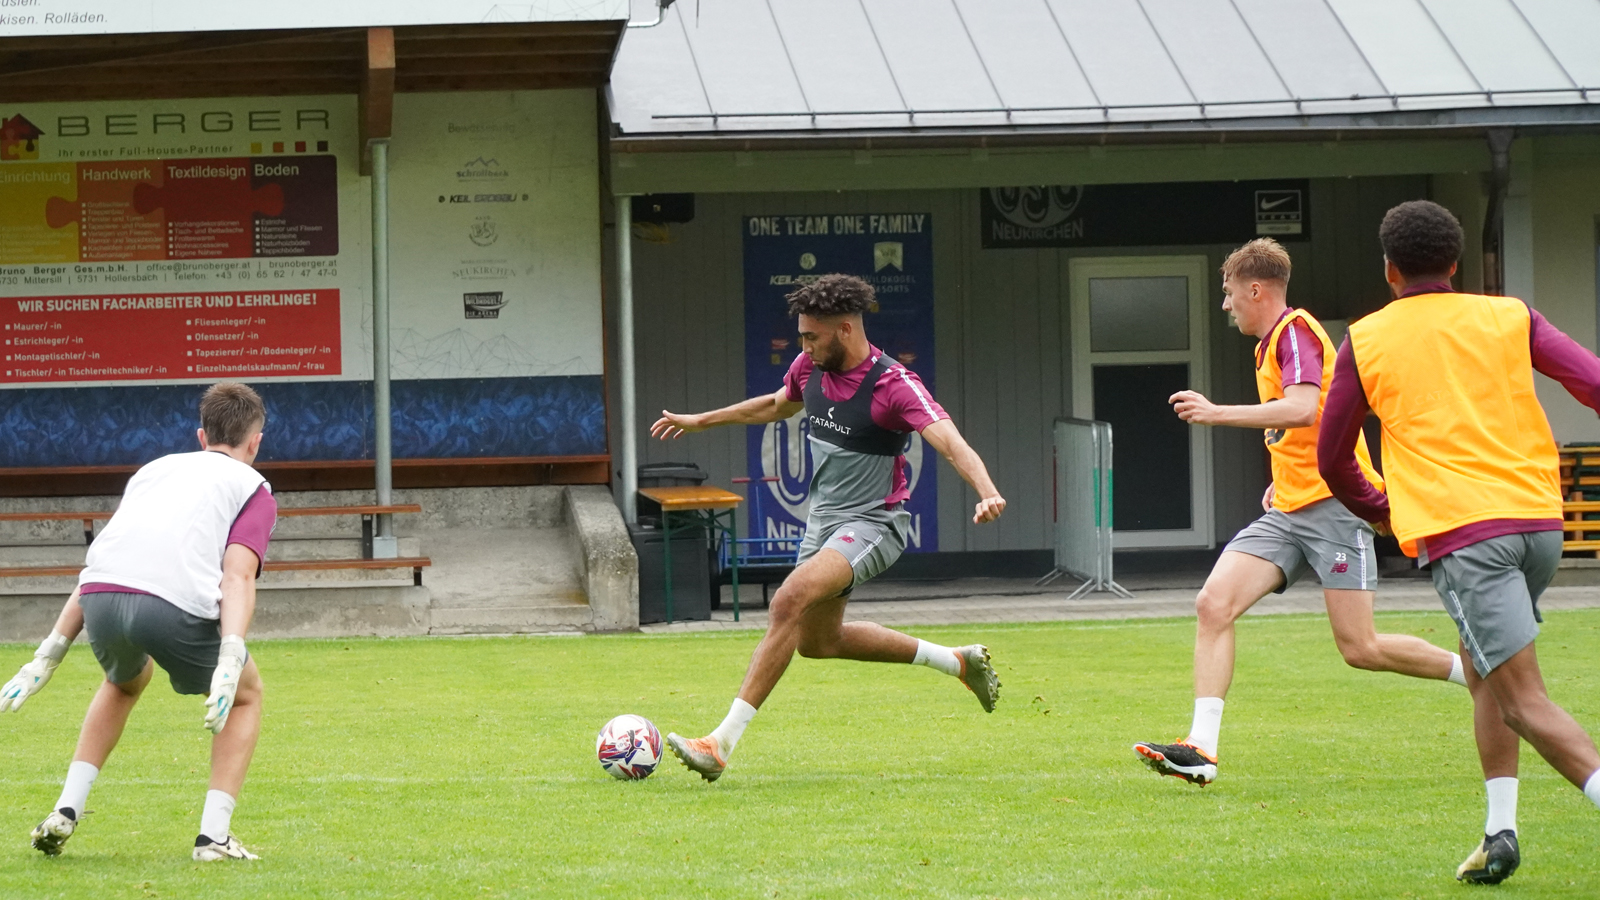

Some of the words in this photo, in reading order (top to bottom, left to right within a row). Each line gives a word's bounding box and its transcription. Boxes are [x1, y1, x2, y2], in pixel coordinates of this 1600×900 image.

[44, 12, 108, 24] Rolläden.
[57, 108, 330, 137] BERGER
[58, 149, 74, 157] Ihr
[79, 149, 114, 157] erster
[82, 166, 151, 181] Handwerk
[167, 165, 246, 180] Textildesign
[254, 163, 299, 176] Boden
[749, 217, 781, 236] ONE
[785, 216, 829, 236] TEAM
[833, 215, 866, 235] ONE
[869, 214, 925, 234] FAMILY
[991, 218, 1084, 241] NEUKIRCHEN
[33, 266, 66, 276] Berger
[74, 264, 128, 274] Ges.m.b.H.
[146, 260, 251, 273] office@brunoberger.at
[269, 260, 337, 270] brunoberger.at
[24, 276, 62, 285] Mittersill
[77, 274, 98, 283] 5731
[105, 273, 158, 282] Hollersbach
[215, 271, 232, 280] +43
[238, 271, 250, 280] (0)
[256, 270, 268, 278] 65
[274, 270, 285, 278] 62
[301, 269, 311, 277] 47
[317, 269, 337, 277] 47-0
[17, 300, 43, 312] WIR
[46, 298, 99, 312] SUCHEN
[102, 296, 202, 310] FACHARBEITER
[205, 295, 233, 308] UND
[236, 293, 317, 307] LEHRLINGE!
[13, 322, 48, 331] Maurer/
[50, 322, 62, 330] -in
[194, 317, 252, 327] Fliesenleger/
[254, 317, 266, 325] -in
[14, 335, 70, 346] Estrichleger/
[71, 336, 83, 344] -in
[195, 331, 245, 341] Ofensetzer/
[247, 332, 259, 340] -in
[14, 351, 86, 362] Montagetischler/
[87, 352, 100, 360] -in
[195, 347, 244, 358] Tapezierer/
[319, 346, 331, 354] -in
[14, 367, 52, 377] Tischler/
[54, 368, 66, 376] -in
[68, 365, 153, 376] Tischlereitechniker/
[155, 365, 167, 374] -in
[195, 362, 301, 373] Einzelhandelskaufmann/
[302, 362, 325, 370] -frau
[809, 415, 852, 435] CATAPULT
[1335, 552, 1347, 562] 23
